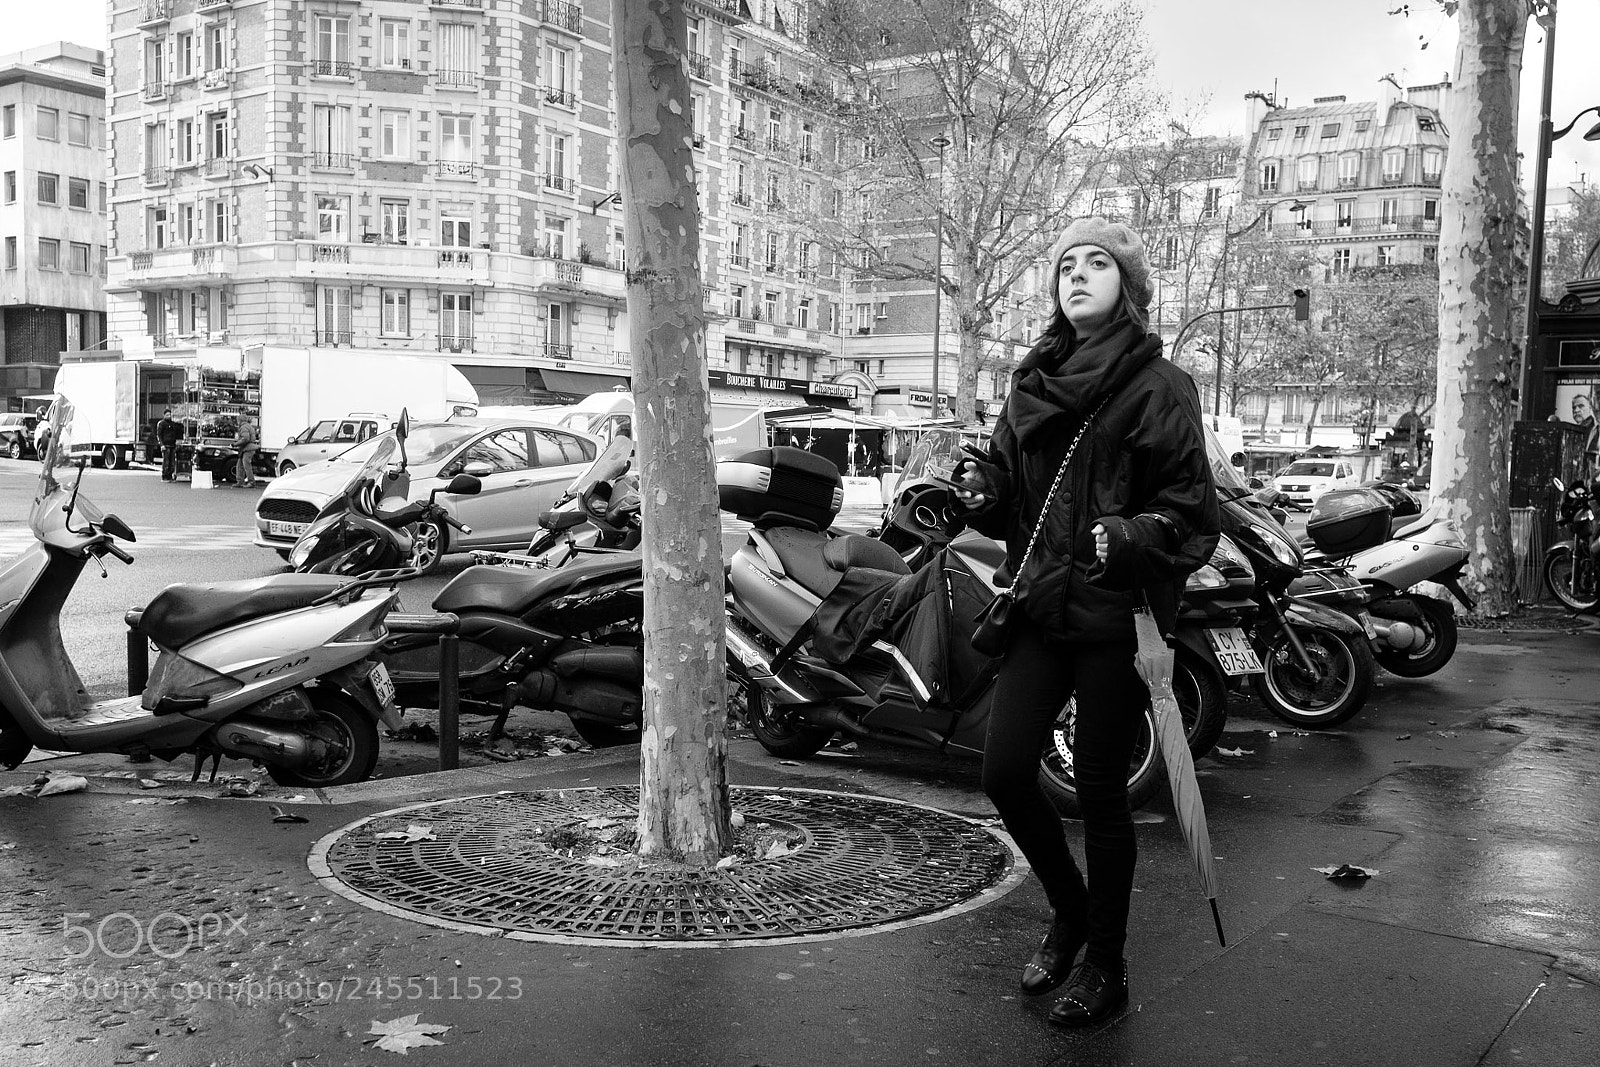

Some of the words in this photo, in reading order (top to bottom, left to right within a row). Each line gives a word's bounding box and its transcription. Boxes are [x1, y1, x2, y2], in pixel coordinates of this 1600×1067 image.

[726, 373, 756, 388] BOUCHERIE
[760, 376, 787, 391] VOLAILLES
[814, 382, 853, 397] Charcuterie
[910, 394, 947, 405] FROMAER
[254, 656, 310, 679] LEAD
